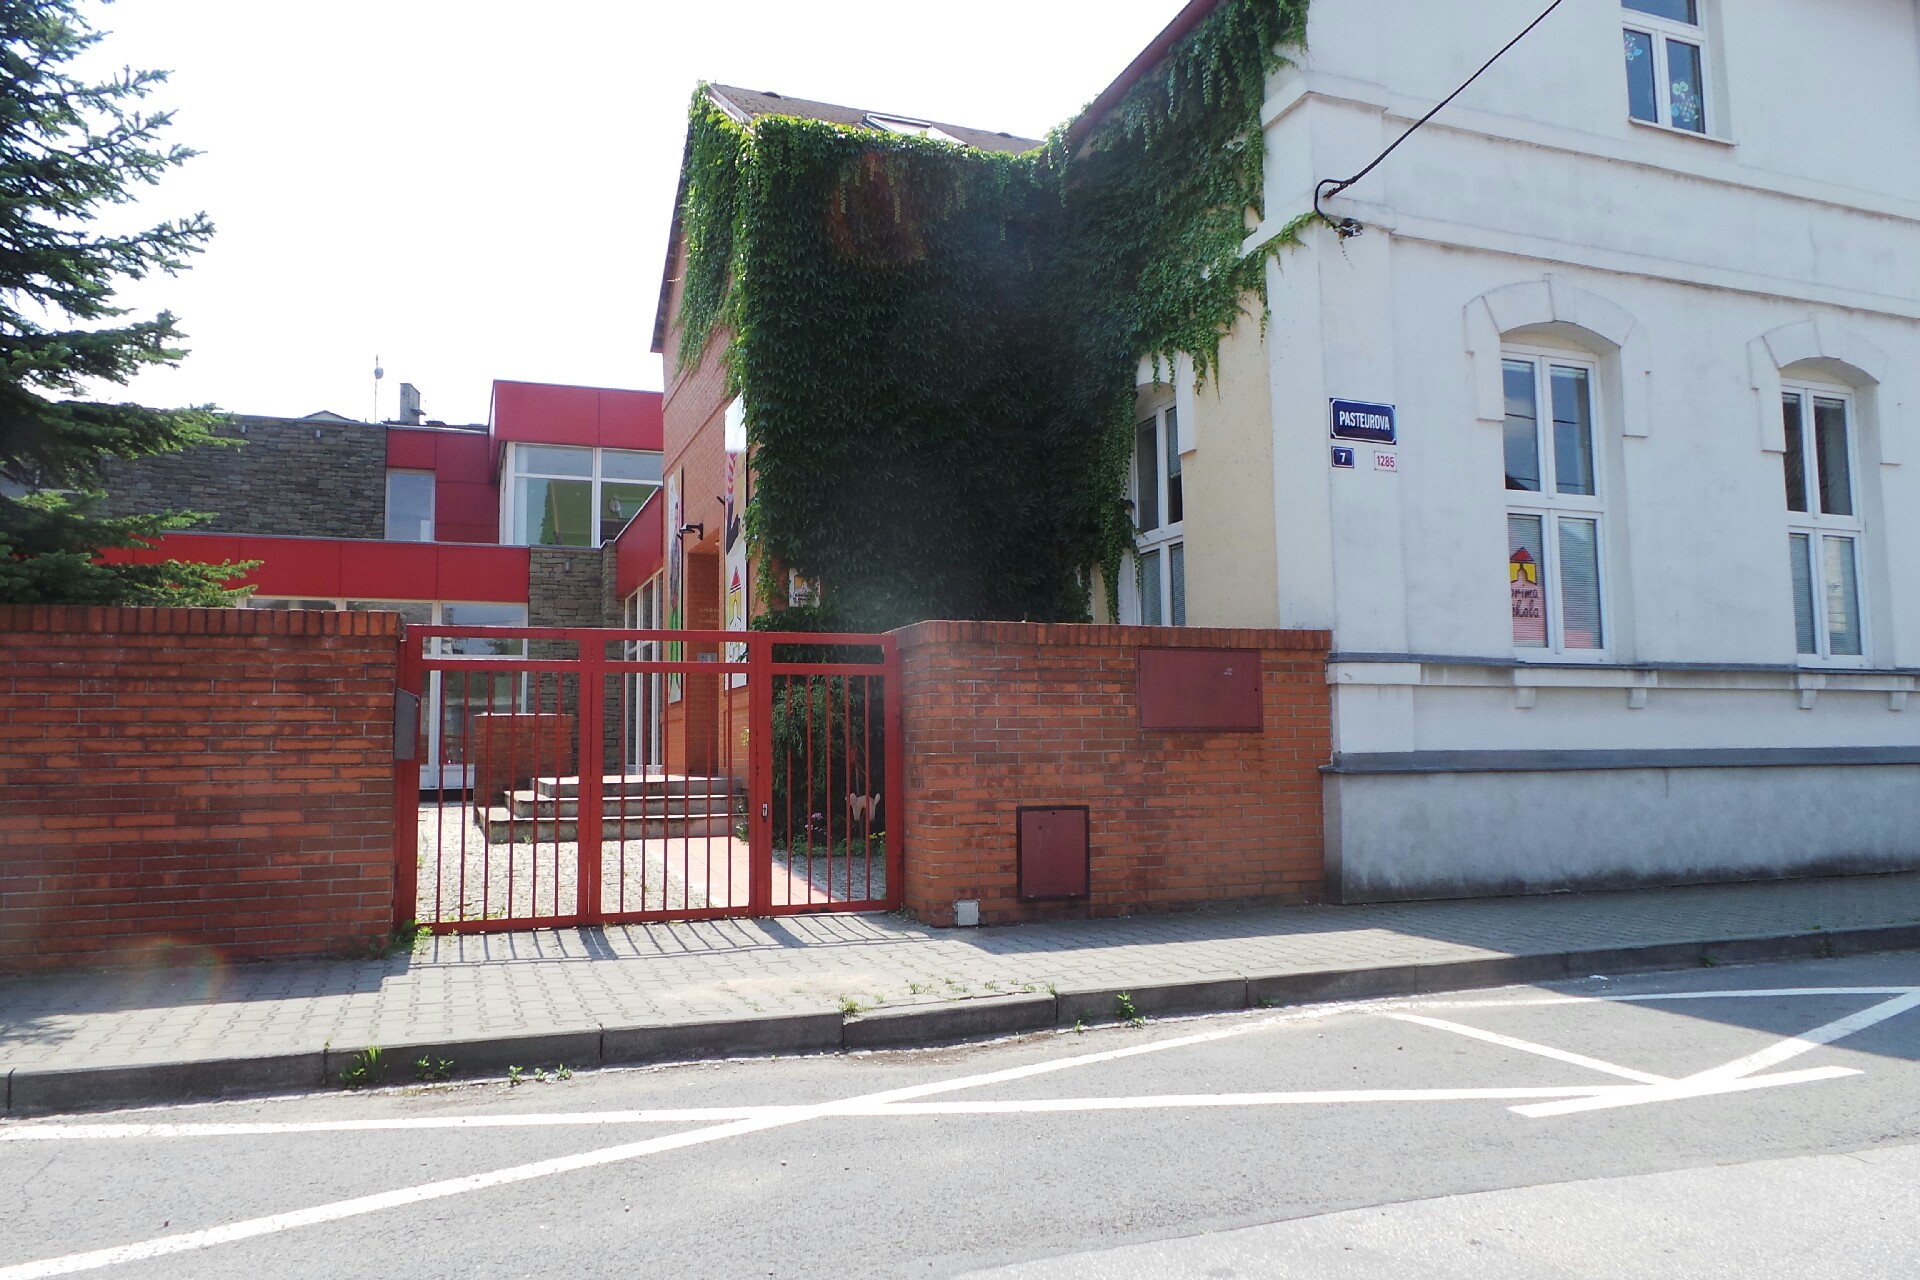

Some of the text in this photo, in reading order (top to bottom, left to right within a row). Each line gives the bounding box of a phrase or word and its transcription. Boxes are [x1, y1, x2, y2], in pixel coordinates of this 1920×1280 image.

[1339, 411, 1390, 430] PASTEUROVA
[1340, 452, 1346, 463] 7
[1376, 455, 1395, 468] 1285
